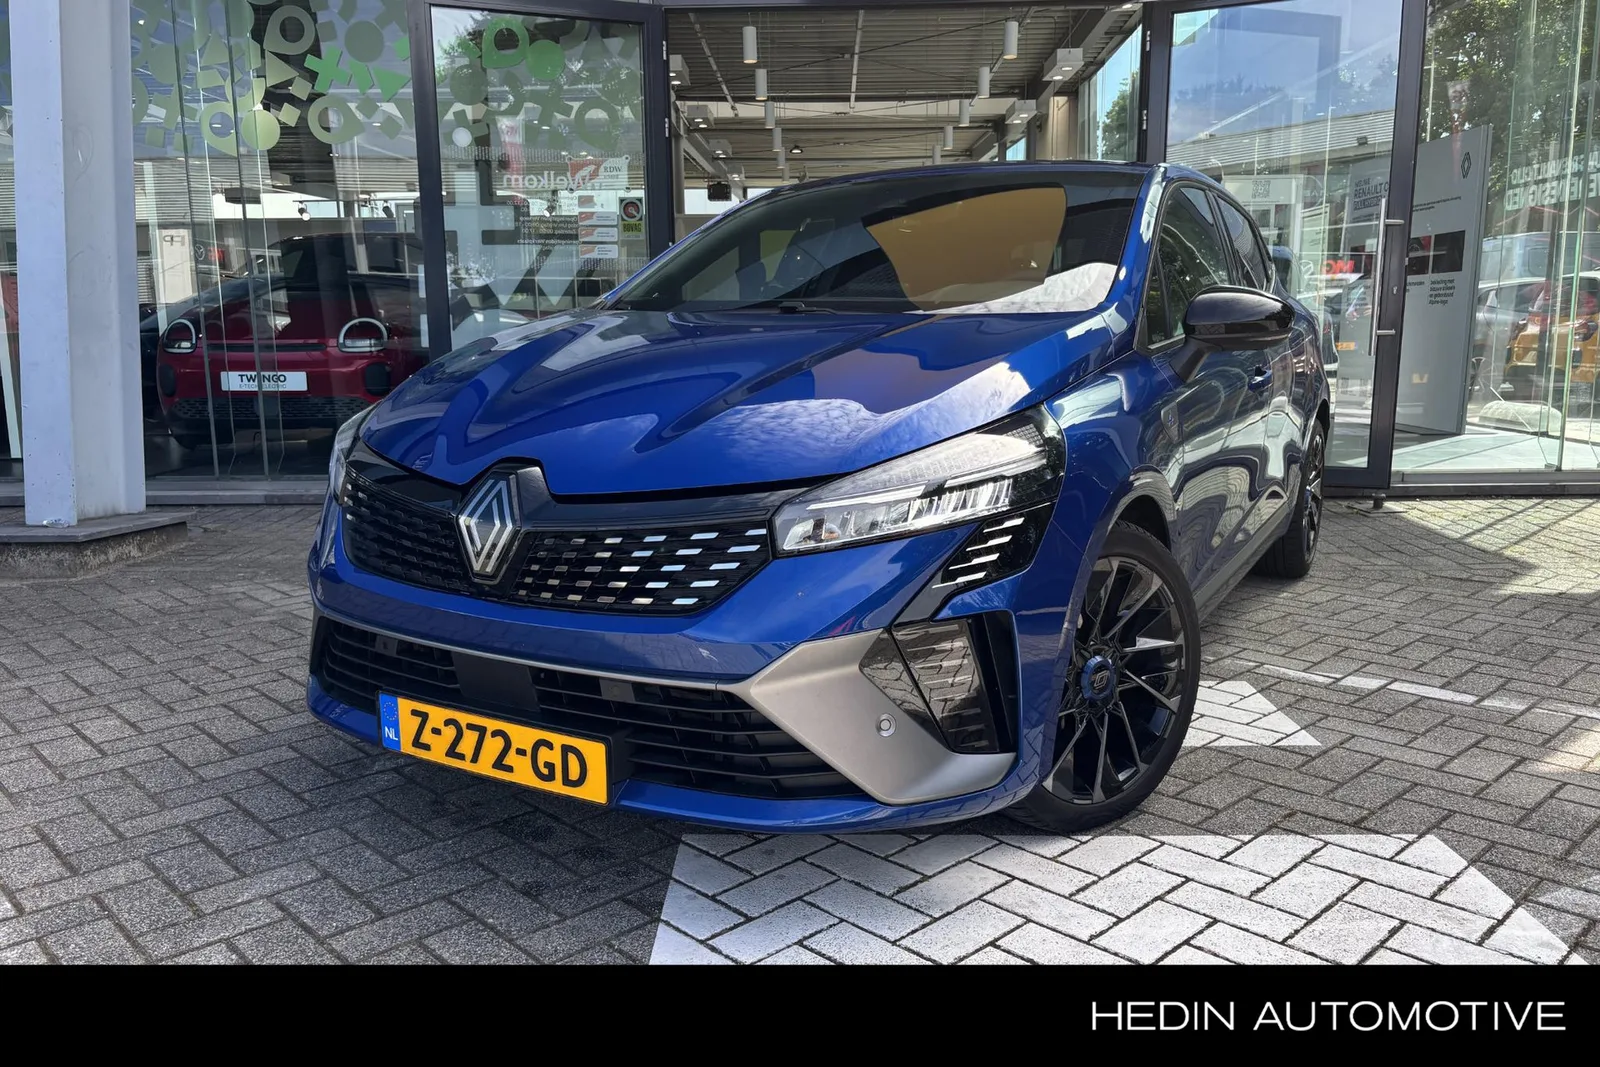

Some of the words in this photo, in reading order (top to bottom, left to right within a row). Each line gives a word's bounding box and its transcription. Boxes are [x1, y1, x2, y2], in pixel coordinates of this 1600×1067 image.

[603, 165, 622, 173] RDW
[1353, 182, 1384, 200] RENAULT
[622, 222, 642, 233] BOVAG
[238, 374, 287, 383] TWNGO
[384, 726, 398, 741] NL
[410, 708, 588, 788] Z-272-GD
